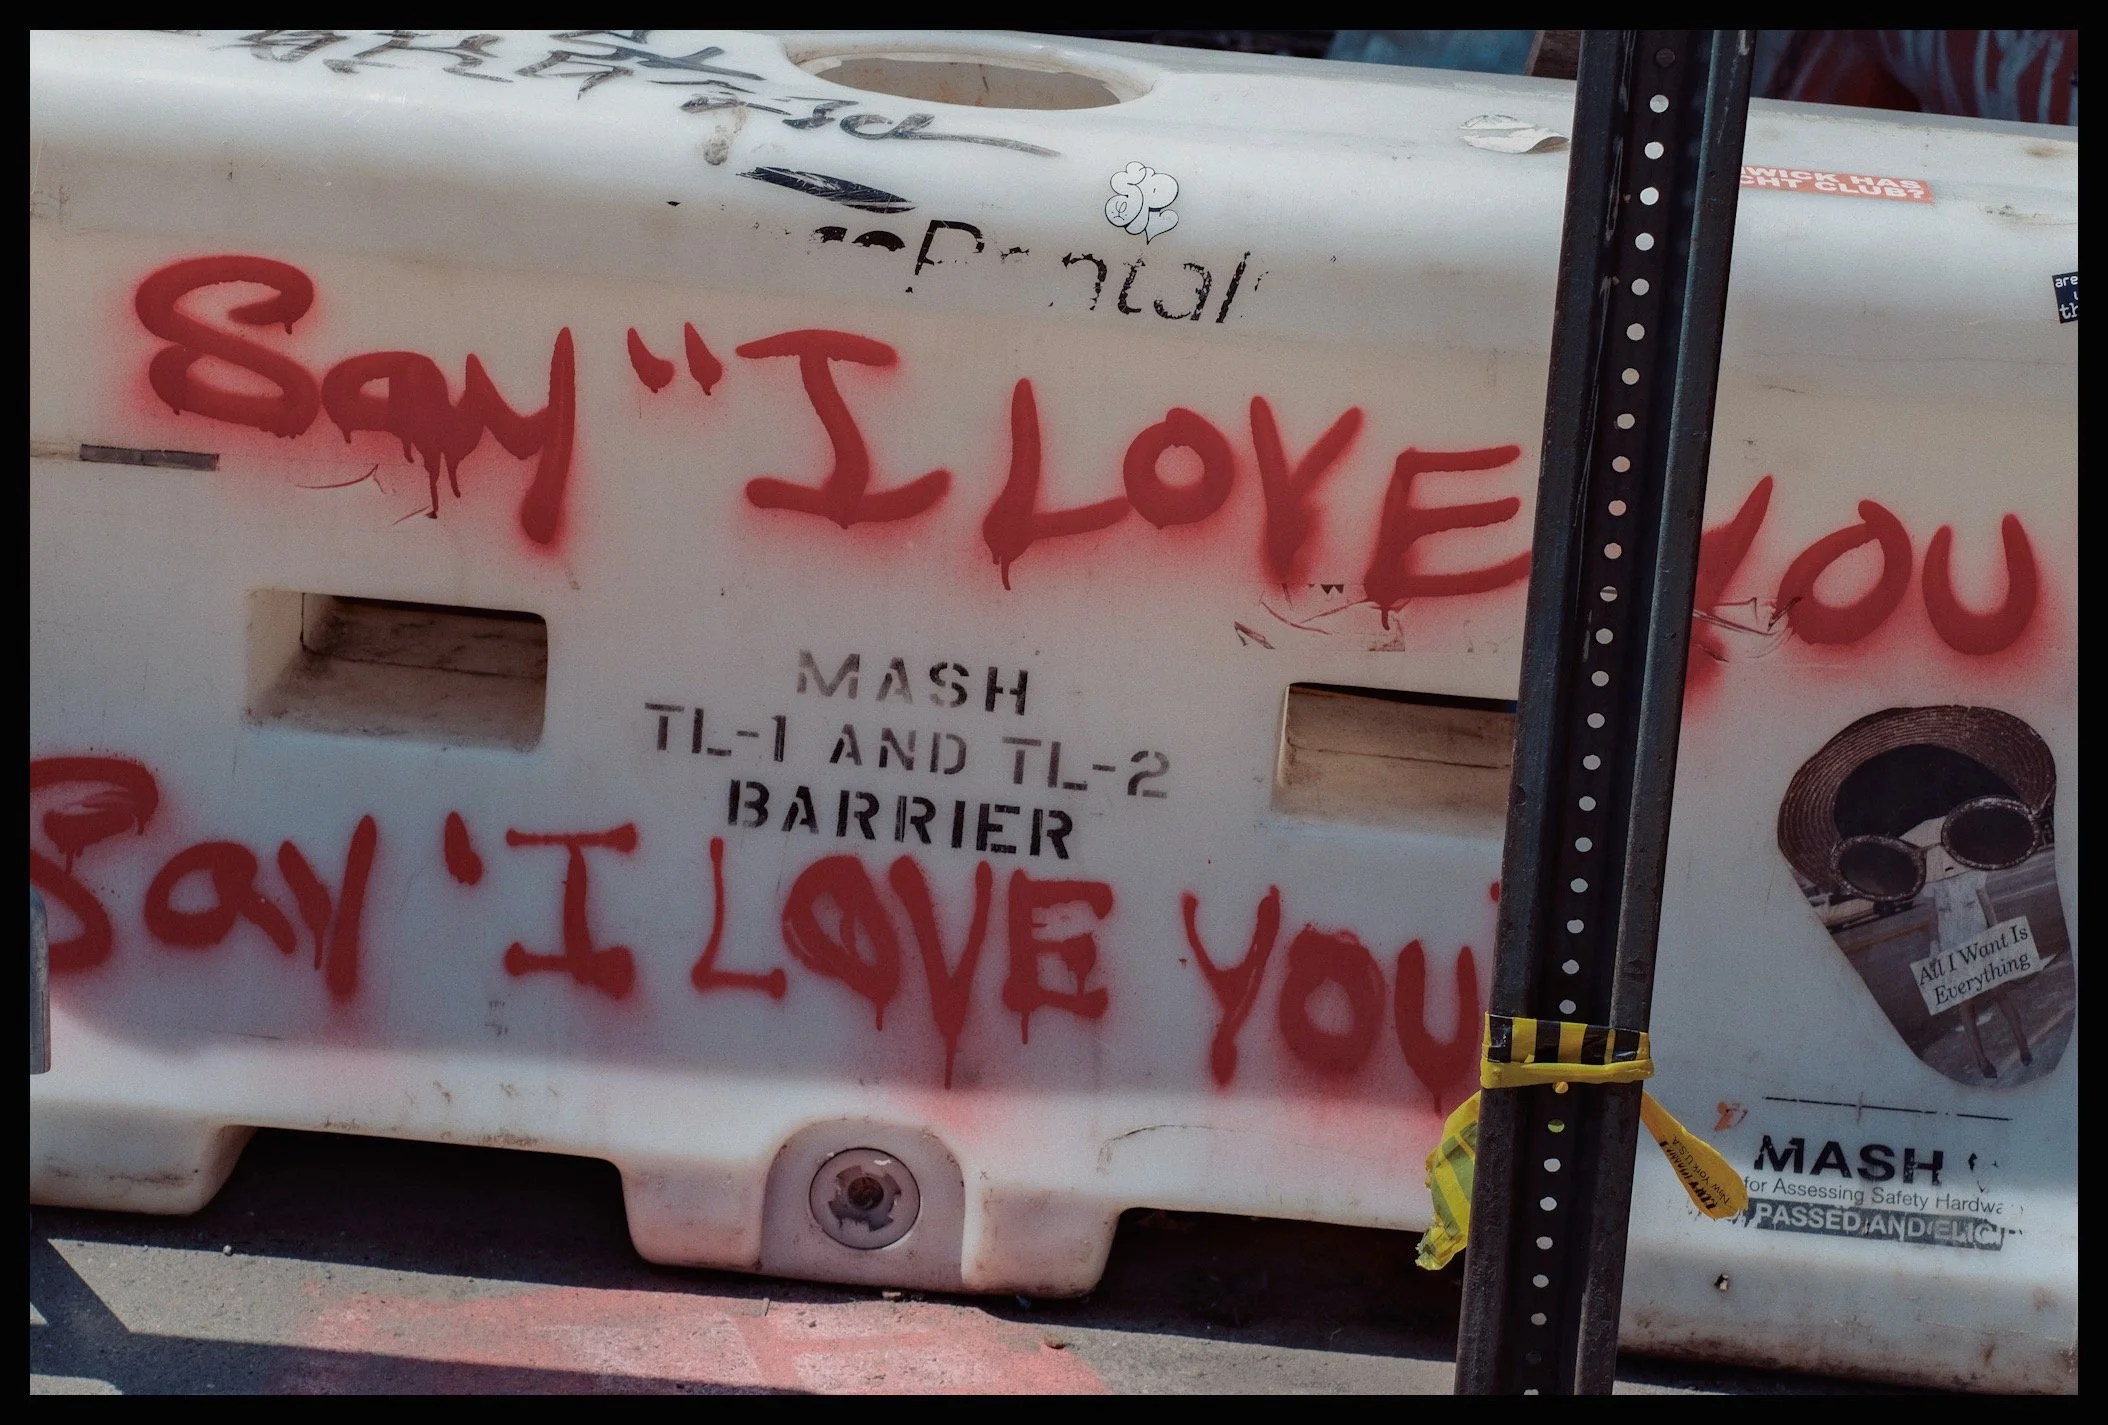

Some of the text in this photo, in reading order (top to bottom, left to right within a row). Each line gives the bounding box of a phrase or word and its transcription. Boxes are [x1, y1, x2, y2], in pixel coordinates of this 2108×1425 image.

[1815, 181, 1924, 199] CLUB?
[1850, 175, 1921, 189] HAS
[2055, 275, 2078, 288] are
[135, 255, 576, 545] Say
[982, 377, 1532, 602] LOVE
[796, 650, 1029, 716] MASH
[644, 702, 1171, 799] TL-1 AND TL-2
[727, 779, 1074, 860] BARRIER
[692, 838, 1114, 1086] LOVE
[1181, 882, 1500, 1112] YOU
[1919, 925, 2028, 986] All I Want Is
[1933, 953, 2031, 1005] Everything
[1753, 1134, 1944, 1186] MASH
[1744, 1176, 1767, 1192] for
[1772, 1177, 1864, 1206] Assessing
[1871, 1186, 1929, 1211] Safety
[1753, 1202, 1861, 1232] PASSED
[1868, 1214, 1926, 1238] AND
